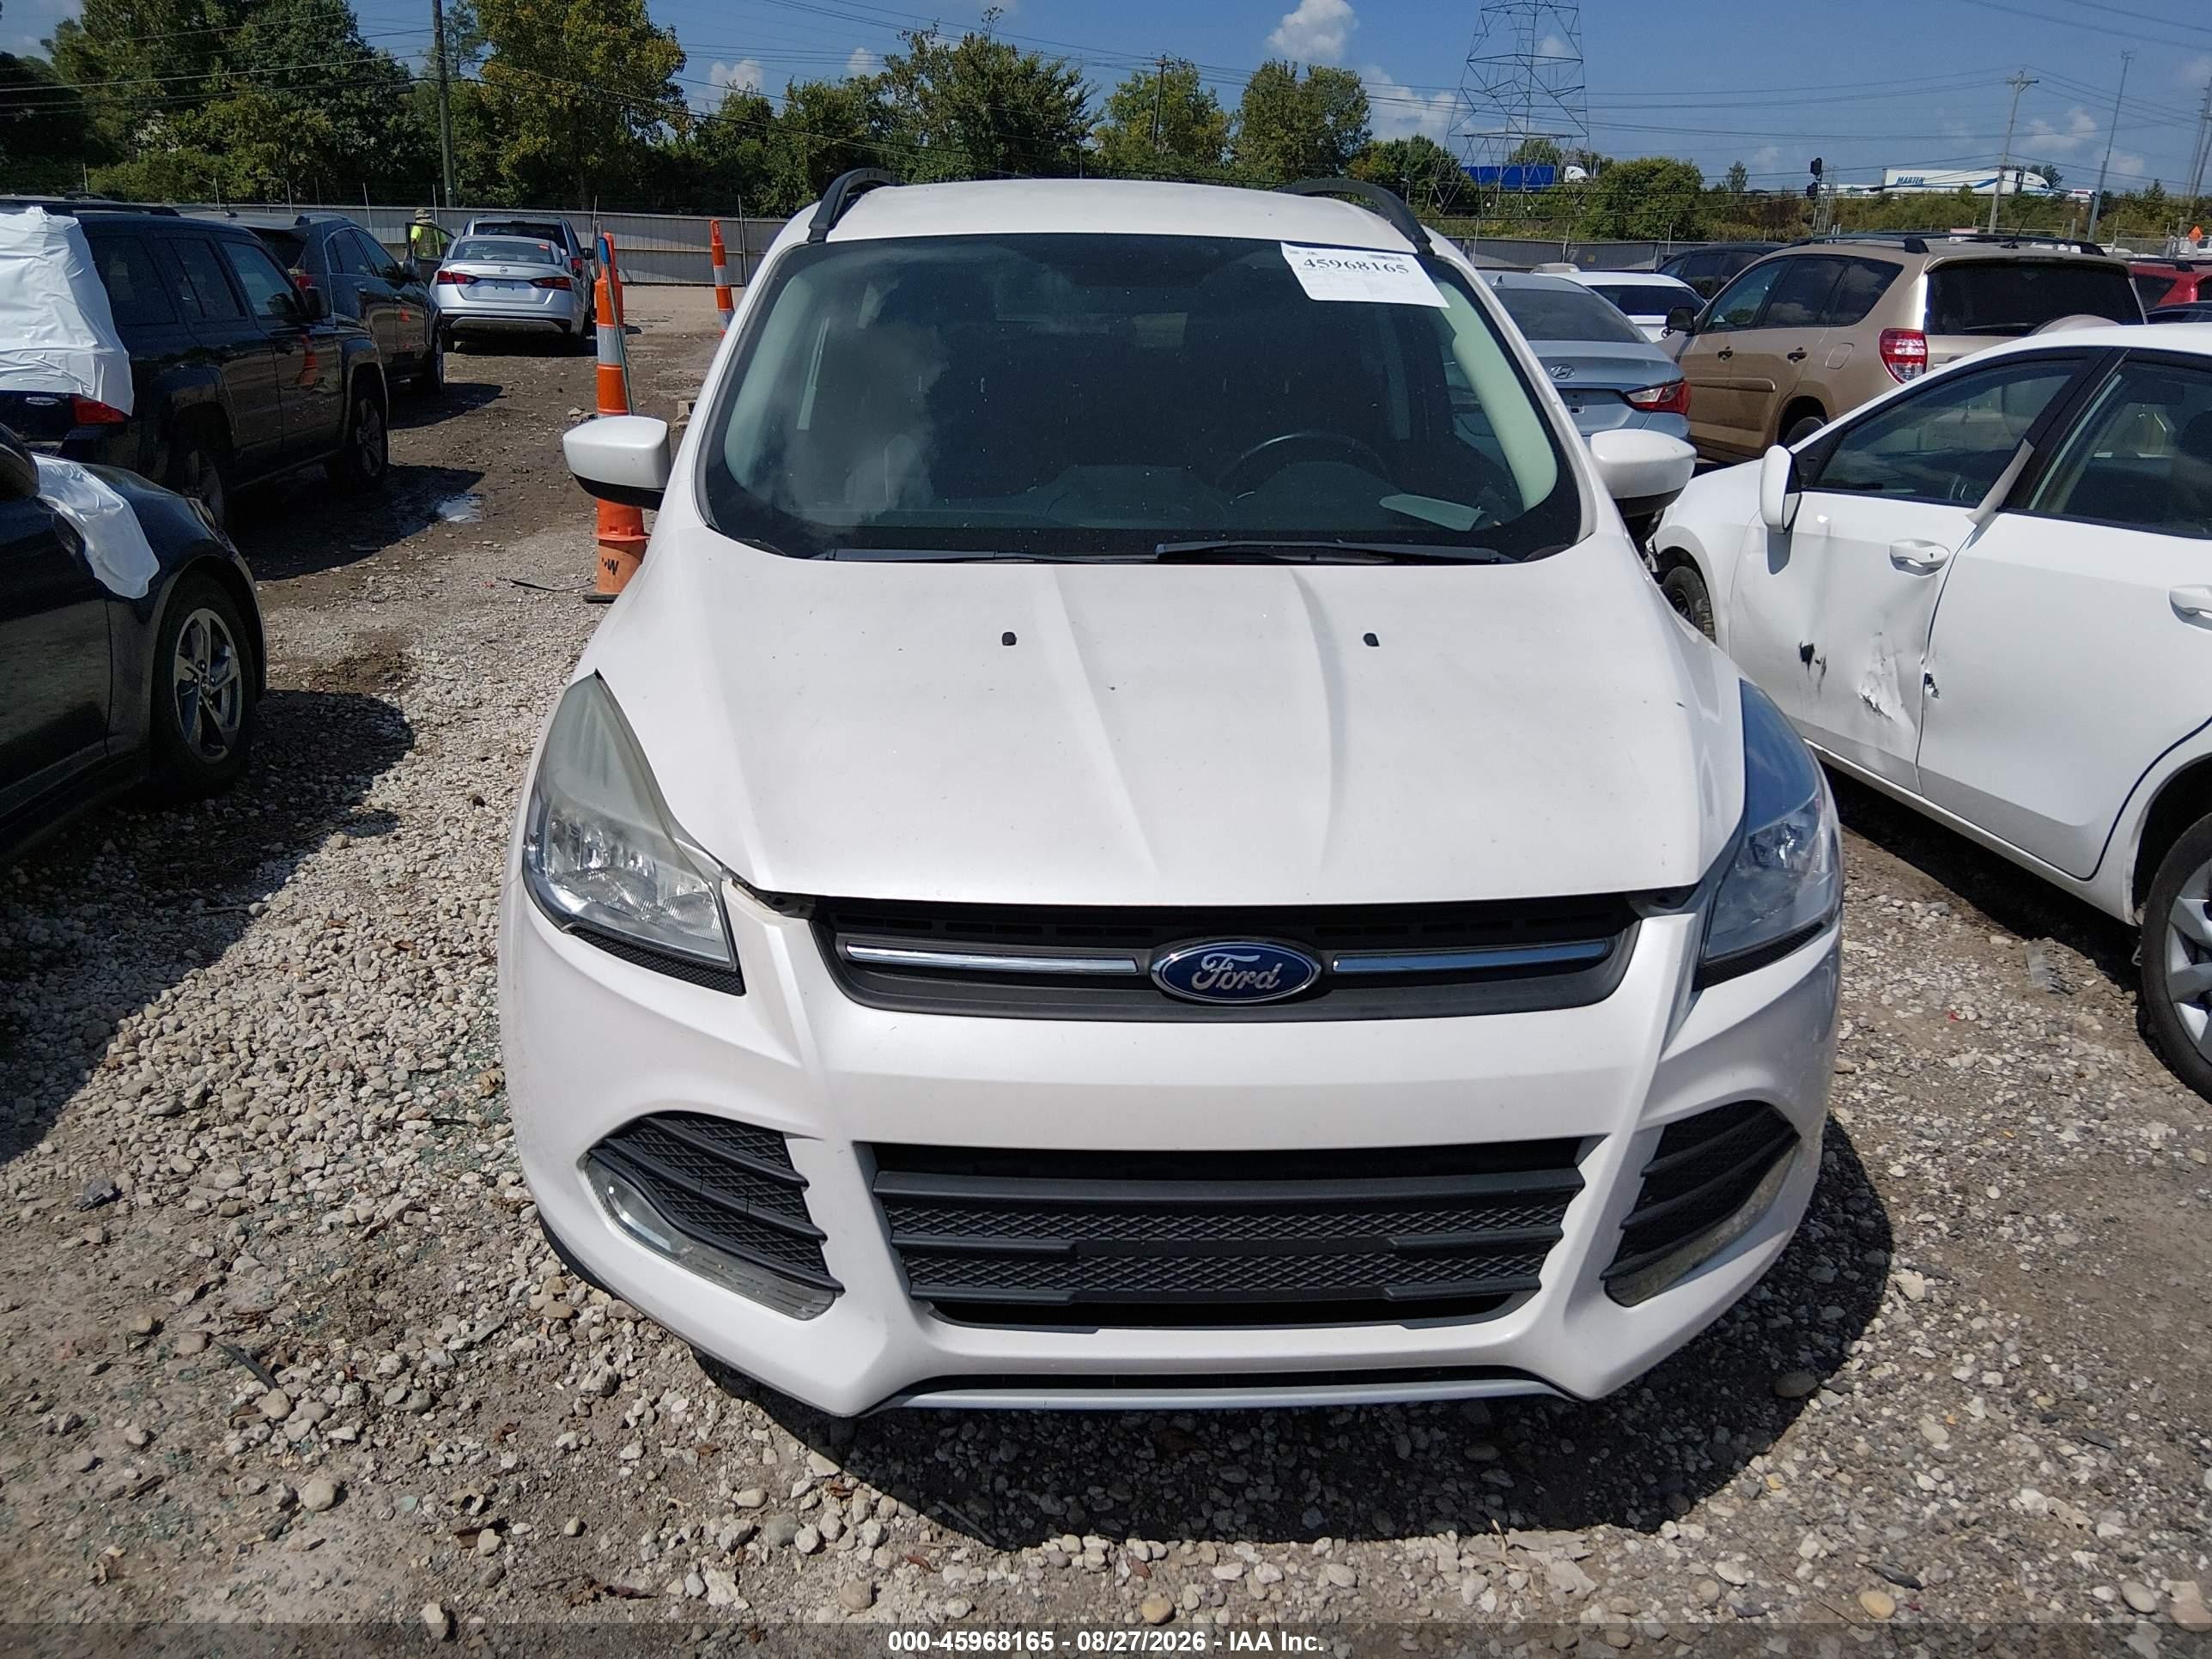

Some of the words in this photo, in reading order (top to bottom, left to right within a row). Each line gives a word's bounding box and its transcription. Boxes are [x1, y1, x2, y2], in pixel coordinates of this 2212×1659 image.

[1896, 176, 1924, 185] MARTEN
[1304, 258, 1409, 274] 45968165
[1191, 952, 1283, 990] Ford
